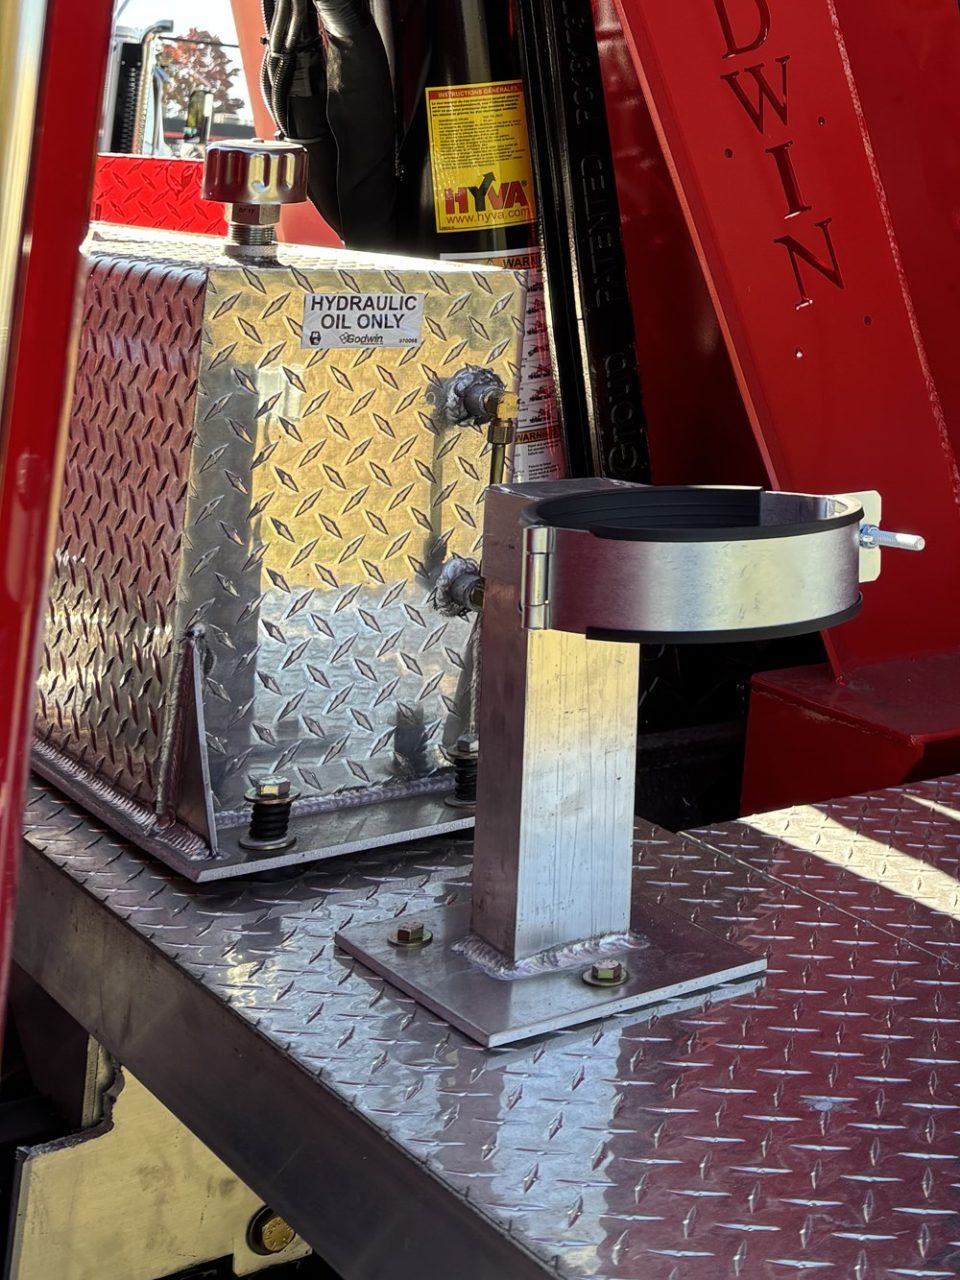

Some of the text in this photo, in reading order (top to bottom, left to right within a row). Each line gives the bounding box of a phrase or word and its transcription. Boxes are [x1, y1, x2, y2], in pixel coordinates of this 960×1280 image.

[444, 172, 529, 215] HYVA
[446, 207, 531, 224] www.hyva.com
[503, 254, 542, 269] WARN
[311, 295, 418, 311] HYDRAULIC
[321, 313, 405, 329] OIL ONLY
[347, 332, 384, 344] Godwin
